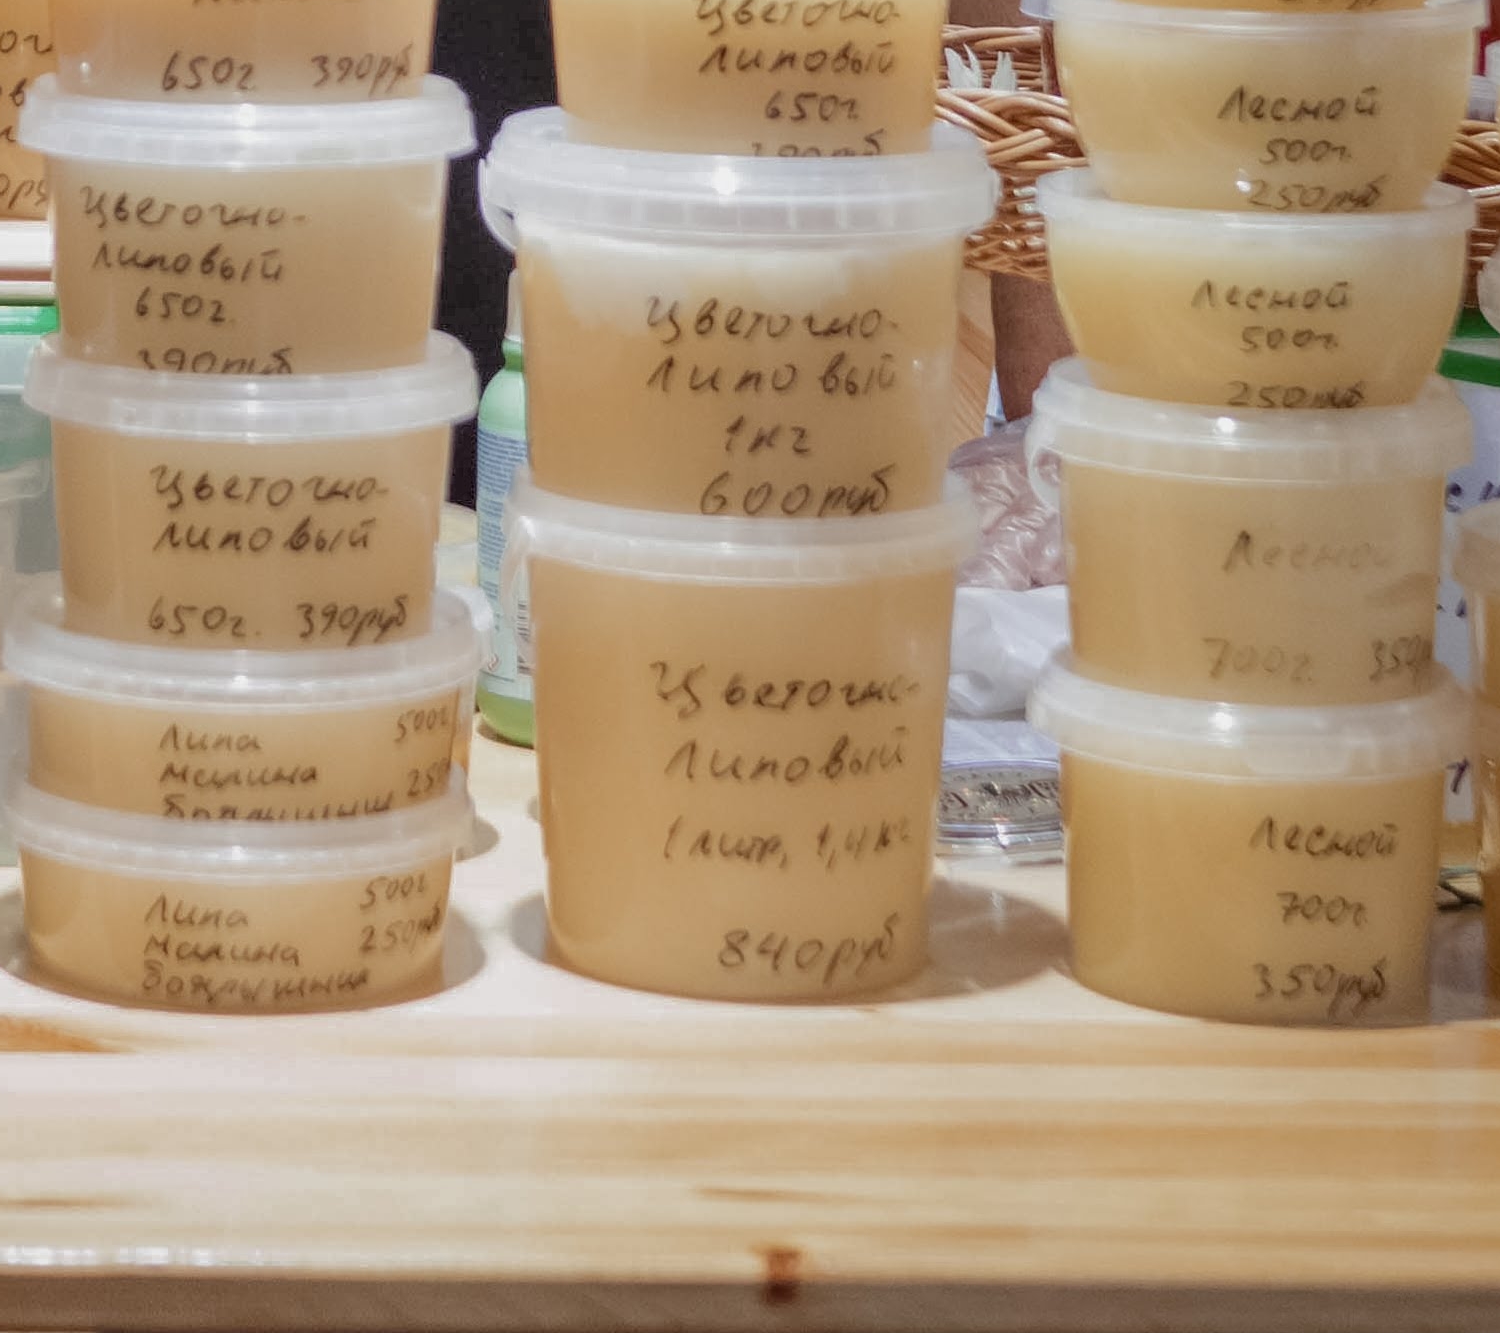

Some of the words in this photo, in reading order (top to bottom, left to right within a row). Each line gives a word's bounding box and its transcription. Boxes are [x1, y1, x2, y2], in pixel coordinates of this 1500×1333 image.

[1216, 84, 1383, 125] Лесной
[1190, 278, 1355, 312] Лесной
[296, 595, 410, 646] 390руб
[716, 911, 901, 984] 840руб
